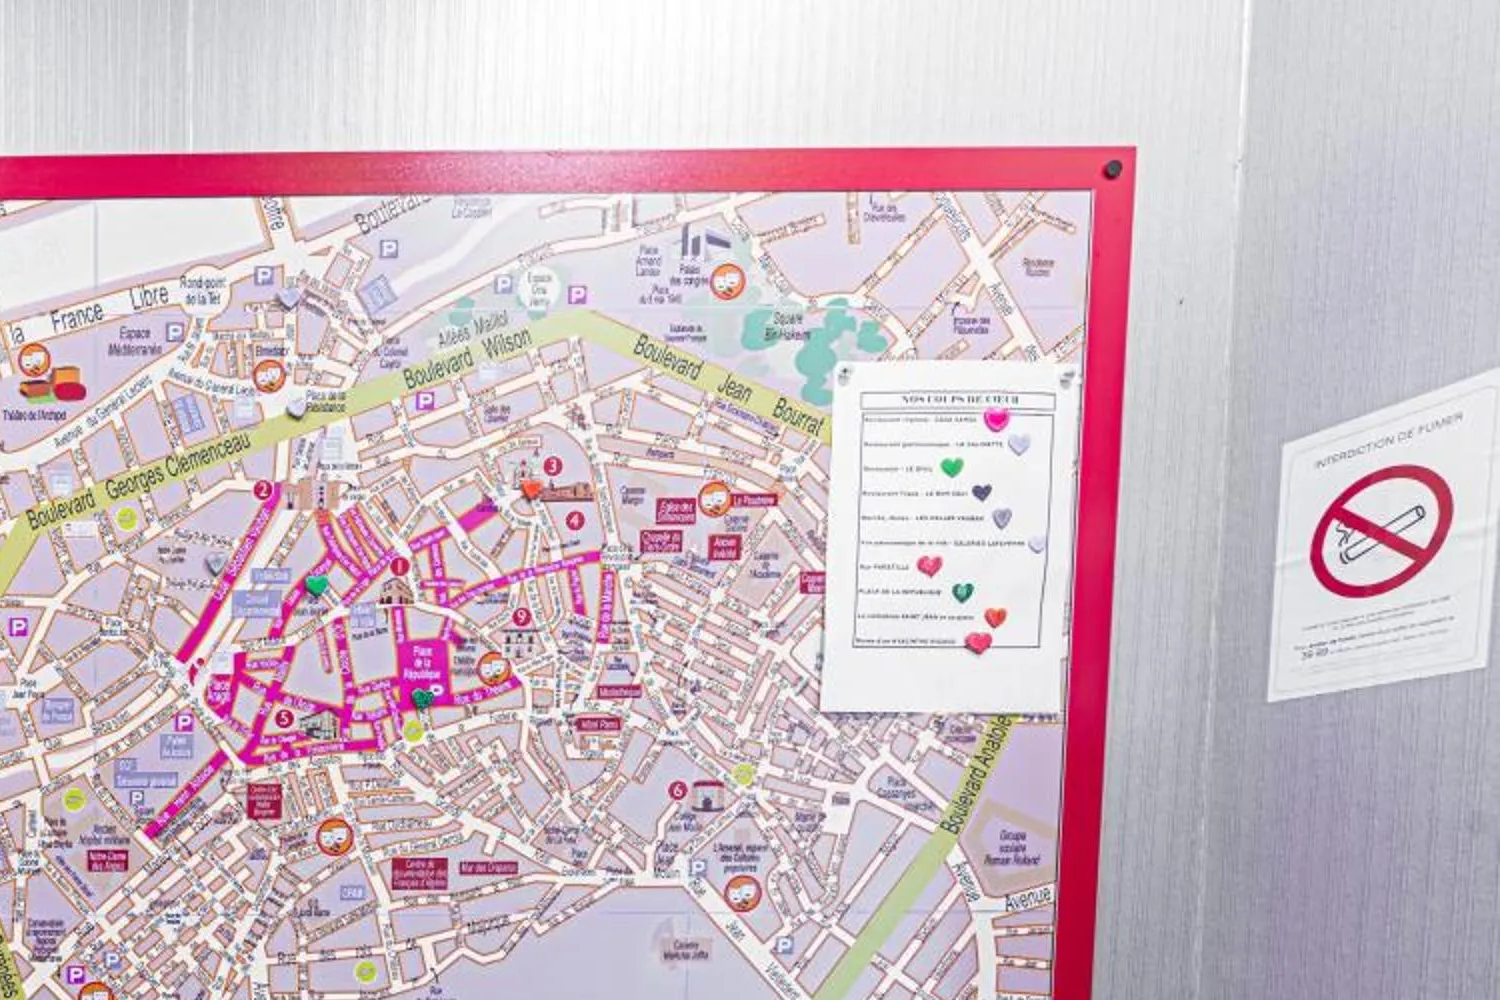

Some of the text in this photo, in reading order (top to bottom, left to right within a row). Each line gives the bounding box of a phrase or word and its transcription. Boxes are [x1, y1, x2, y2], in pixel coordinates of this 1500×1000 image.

[8, 324, 26, 346] la
[51, 302, 104, 333] France
[129, 285, 169, 312] Libre
[402, 328, 532, 389] Boulevard Wilson
[633, 333, 825, 437] Boulevard Jean Bourrat
[1314, 434, 1395, 470] INTERDICTION
[26, 489, 97, 529] Boulevard
[105, 468, 165, 500] Georges
[939, 770, 983, 836] Boulevard
[1005, 887, 1052, 912] Avenue
